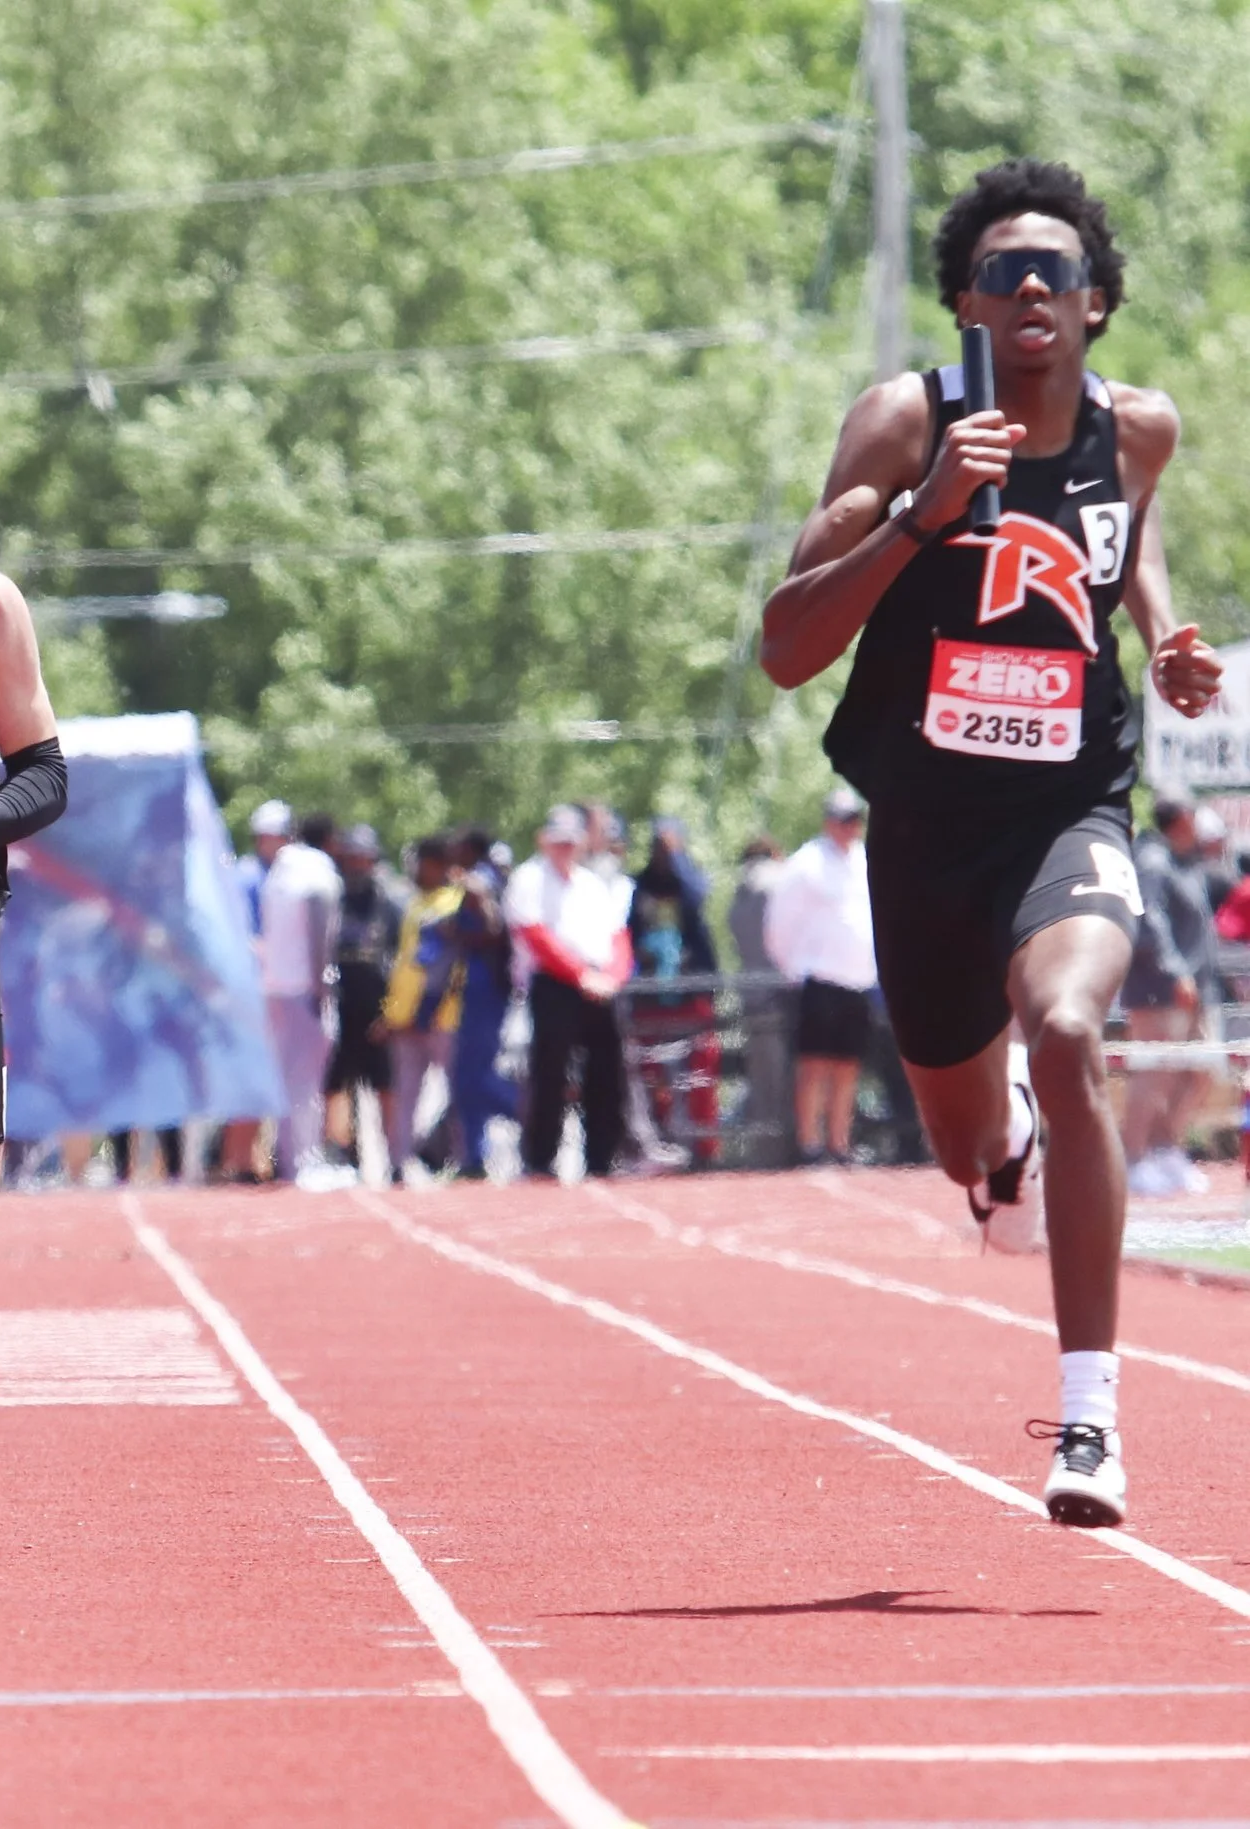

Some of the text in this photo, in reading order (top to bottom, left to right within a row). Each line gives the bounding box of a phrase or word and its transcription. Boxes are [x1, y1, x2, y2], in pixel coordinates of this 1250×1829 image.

[1096, 511, 1117, 579] 3
[944, 510, 1100, 657] R
[947, 657, 1070, 700] ZERO
[963, 712, 1044, 747] 2355
